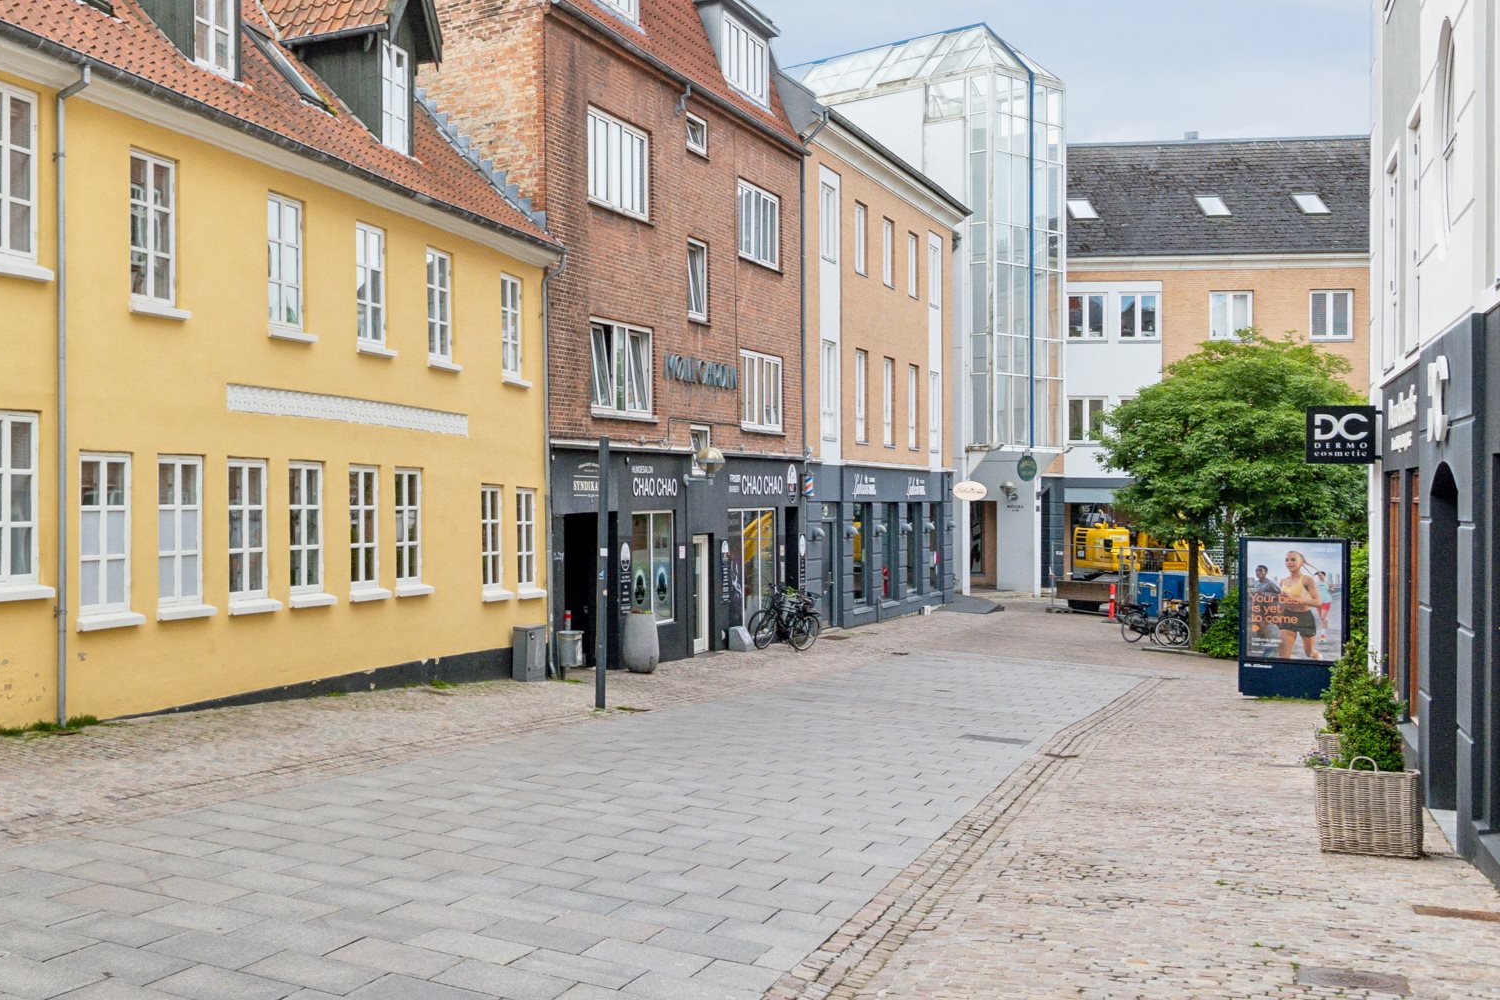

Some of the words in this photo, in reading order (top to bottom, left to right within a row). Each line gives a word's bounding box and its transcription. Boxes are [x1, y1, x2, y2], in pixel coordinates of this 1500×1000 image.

[1314, 413, 1369, 440] DC
[573, 480, 599, 492] SYNDIKA
[632, 477, 655, 497] CHAO
[656, 478, 678, 497] CHAO
[741, 475, 762, 495] CHAO
[763, 475, 783, 495] CHAO
[1250, 593, 1275, 603] Your
[1251, 604, 1261, 613] is
[1263, 605, 1283, 615] yet
[1251, 615, 1263, 623] to
[1265, 616, 1298, 624] come
